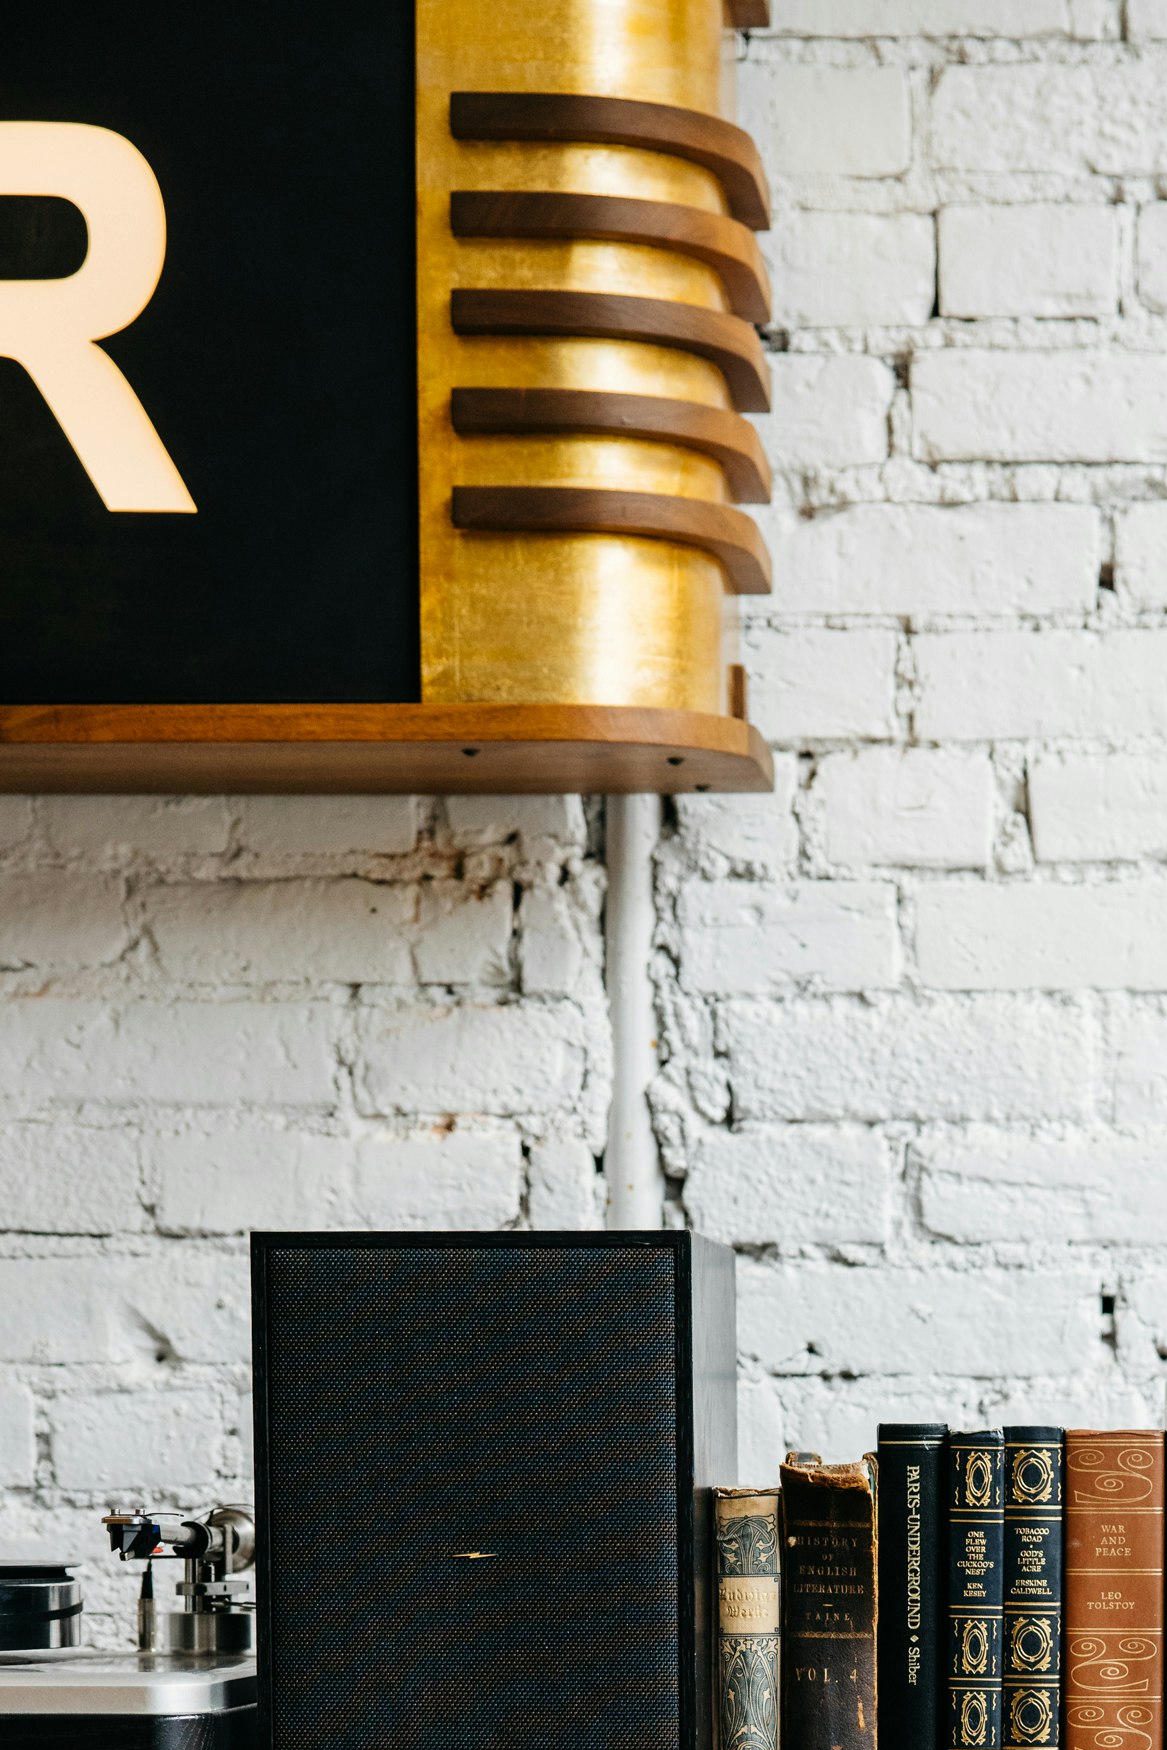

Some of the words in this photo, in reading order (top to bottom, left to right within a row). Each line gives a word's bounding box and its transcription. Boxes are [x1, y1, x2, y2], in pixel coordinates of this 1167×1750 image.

[1014, 1527, 1050, 1535] TOBACCO
[1100, 1524, 1126, 1533] WAR
[796, 1535, 859, 1548] HISTORY
[965, 1538, 987, 1546] FLEW
[1100, 1536, 1126, 1545] AND
[1020, 1550, 1044, 1558] GOD'S
[1095, 1547, 1132, 1556] PEACE
[967, 1553, 984, 1561] THE
[798, 1566, 858, 1577] ENGLISH
[965, 1568, 987, 1576] NEST
[1021, 1565, 1042, 1573] ACRE
[1015, 1579, 1048, 1587] ERSKINE
[793, 1583, 865, 1595] LITERATURE
[1010, 1587, 1053, 1595] CALDWELL
[963, 1590, 987, 1598] KESEY
[1100, 1591, 1122, 1600] LEO
[1086, 1601, 1135, 1610] TOLSTOY
[804, 1611, 851, 1622] TAINE
[908, 1647, 921, 1686] Shiber
[795, 1667, 840, 1684] VOL.
